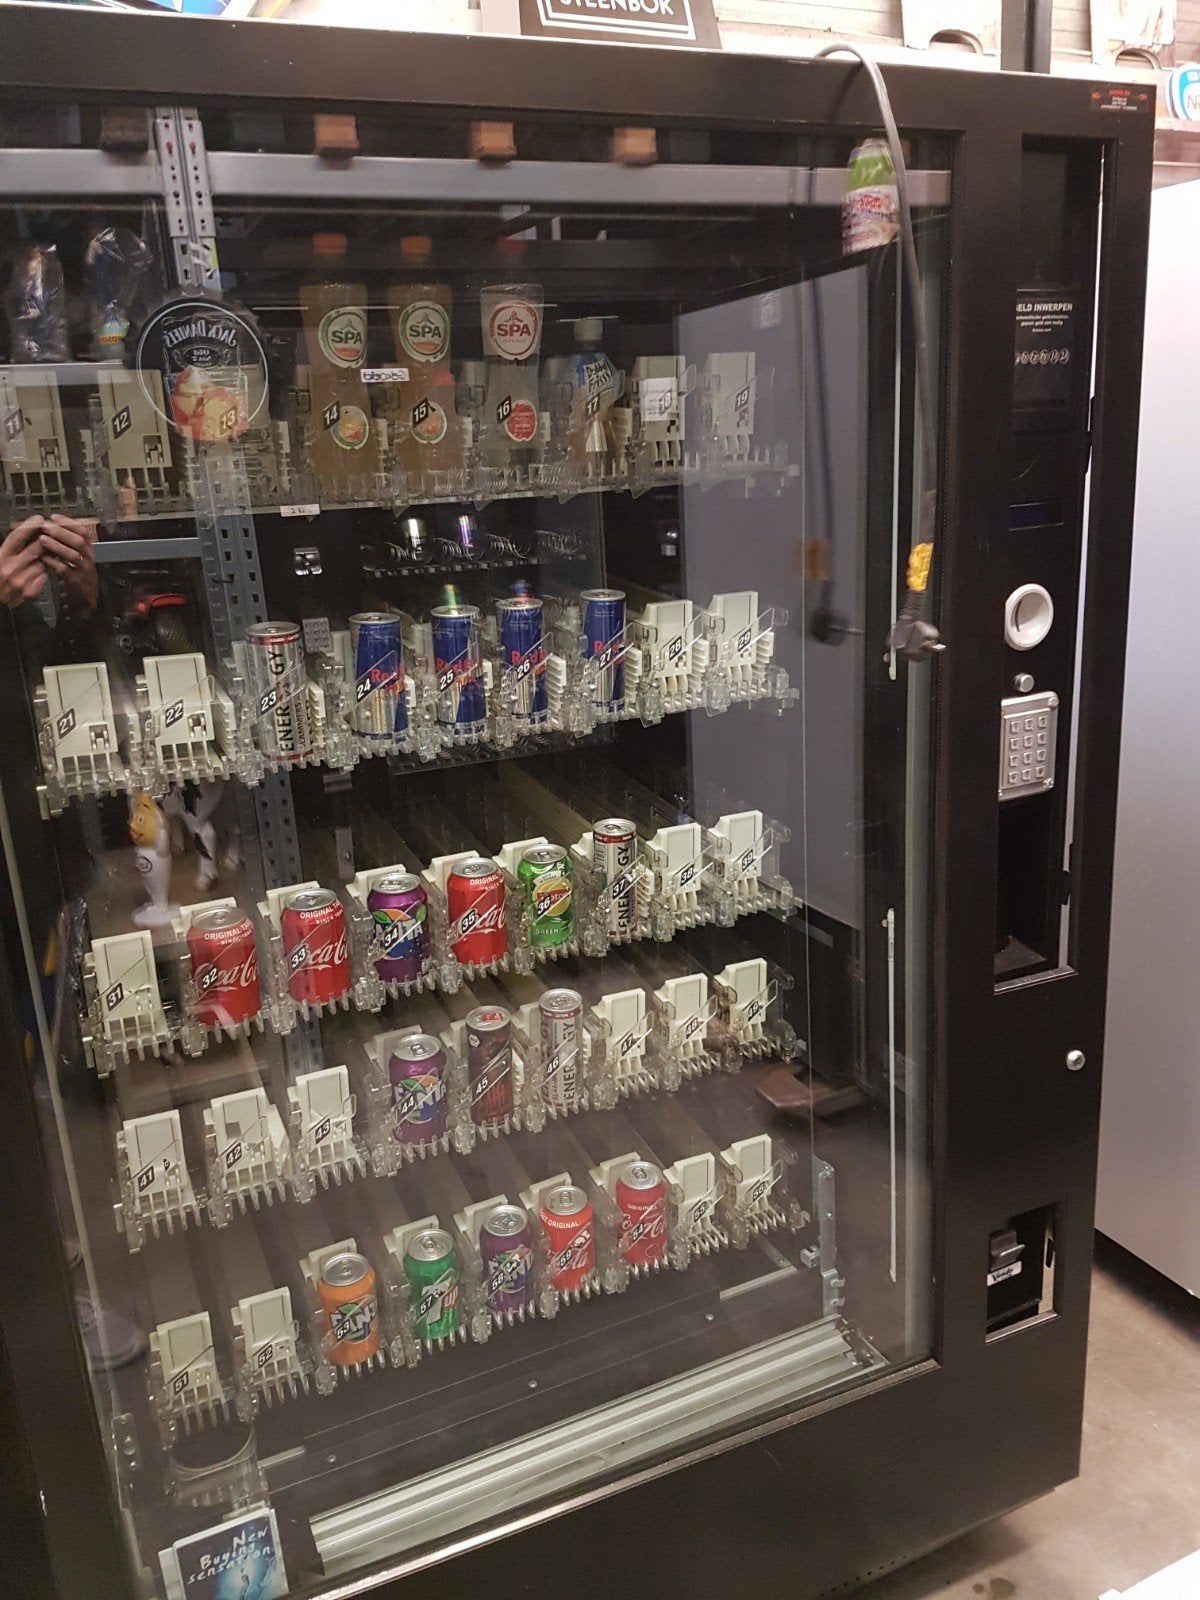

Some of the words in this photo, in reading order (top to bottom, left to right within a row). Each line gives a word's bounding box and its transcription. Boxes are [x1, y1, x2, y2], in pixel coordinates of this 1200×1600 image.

[1034, 302, 1073, 312] INWERPEN
[331, 330, 363, 345] SPA
[408, 324, 442, 339] SPA
[497, 323, 532, 338] SPA
[6, 414, 20, 434] 11
[113, 411, 129, 432] 12
[220, 409, 236, 429] 13
[324, 404, 339, 425] 14
[413, 402, 427, 422] 15
[497, 400, 510, 419] 16
[586, 396, 600, 415] 17
[659, 392, 672, 411] 18
[736, 390, 748, 407] 19
[59, 714, 75, 734] 21
[165, 701, 183, 724] 22
[261, 690, 277, 711] 23
[357, 678, 371, 699] 24
[440, 669, 453, 689] 25
[518, 660, 530, 679] 26
[600, 648, 612, 665] 27
[670, 638, 682, 656] 28
[738, 631, 751, 648] 29
[470, 874, 499, 886] ORIGINAL
[299, 906, 334, 919] ORIGINAL
[108, 988, 122, 1006] 31
[202, 967, 217, 988] 32
[291, 947, 306, 968] 33
[384, 927, 398, 947] 34
[462, 911, 475, 930] 35
[536, 896, 551, 914] 36
[613, 879, 625, 897] 37
[681, 865, 693, 884] 38
[742, 853, 754, 869] 39
[204, 928, 242, 941] ORIGINAL
[139, 1169, 154, 1187] 41
[226, 1146, 242, 1165] 42
[315, 1122, 331, 1141] 43
[402, 1095, 414, 1113] 44
[476, 1076, 488, 1094] 45
[547, 1056, 559, 1073] 46
[621, 1033, 633, 1051] 47
[686, 1018, 698, 1036] 48
[547, 1220, 580, 1230] ORIGINAL
[175, 1376, 188, 1393] 51
[259, 1349, 272, 1367] 52
[336, 1321, 349, 1339] 53
[420, 1297, 432, 1313] 57
[492, 1273, 503, 1290] 58
[560, 1249, 571, 1267] 59
[633, 1223, 643, 1240] 54
[695, 1203, 706, 1219] 55
[753, 1184, 764, 1200] 56
[233, 1527, 268, 1550] New
[187, 1546, 271, 1585] sensation
[199, 1543, 255, 1570] Buying
